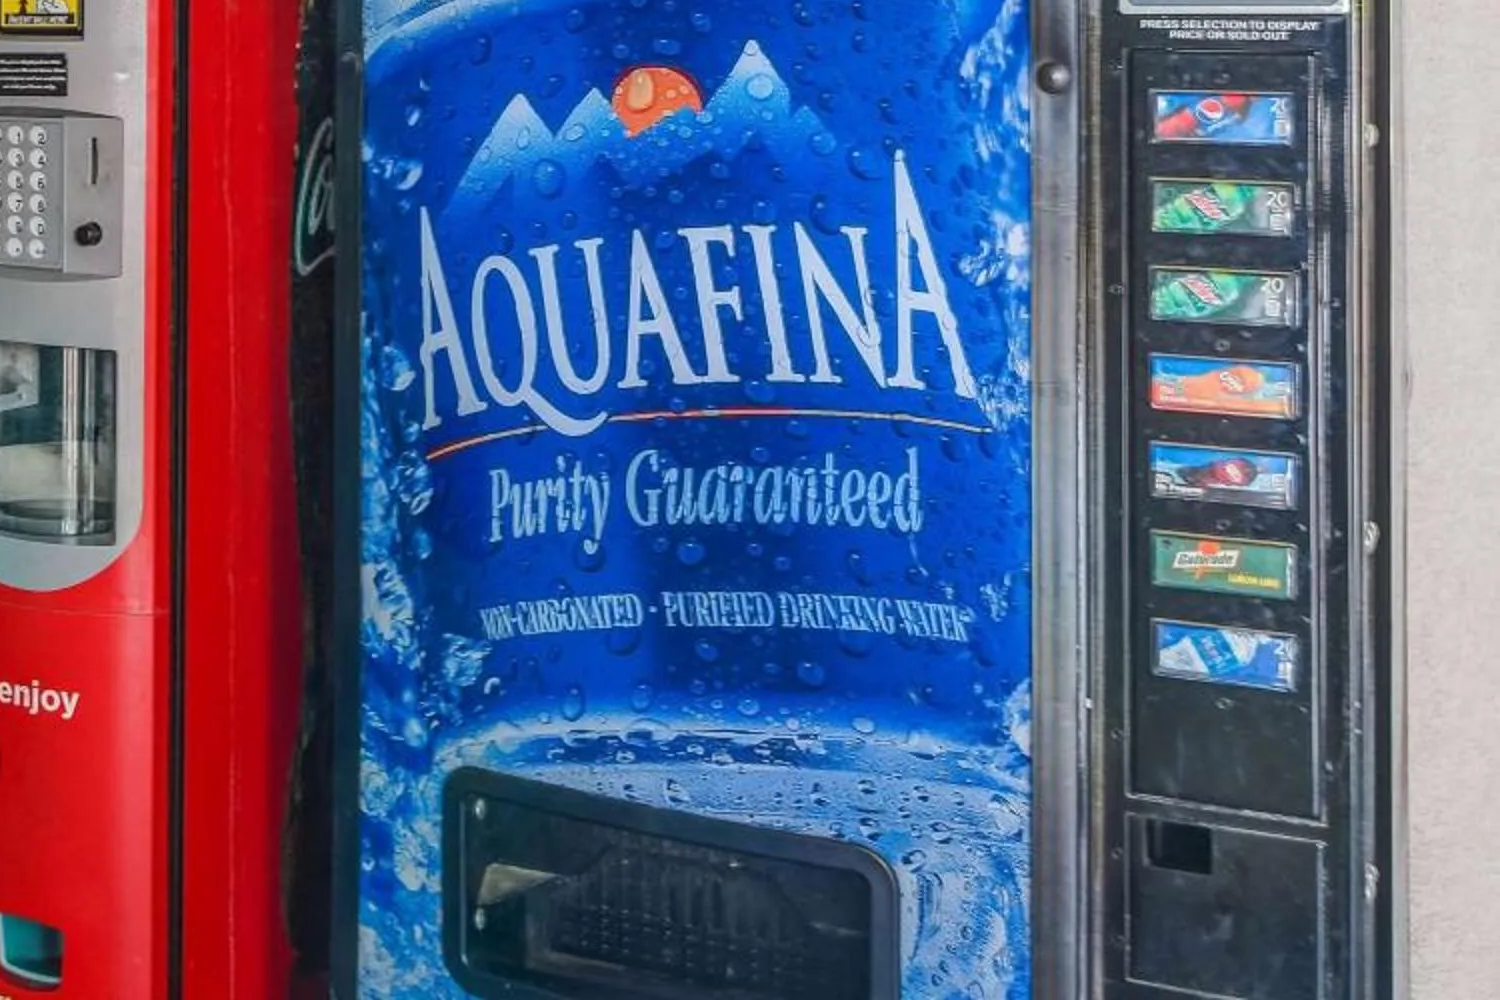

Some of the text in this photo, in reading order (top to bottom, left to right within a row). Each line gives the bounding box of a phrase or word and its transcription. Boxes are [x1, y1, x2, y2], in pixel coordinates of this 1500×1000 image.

[1139, 19, 1180, 30] PRESS
[1181, 20, 1248, 30] SELECTION
[1250, 20, 1265, 30] TO
[1169, 31, 1205, 40] PRICE
[1226, 31, 1260, 41] SOLD
[421, 148, 978, 437] AQUAFINA
[488, 446, 923, 554] Purity Guaranteed
[480, 591, 971, 644] NON-CARBONATED PURIFIED DRINKING WATER
